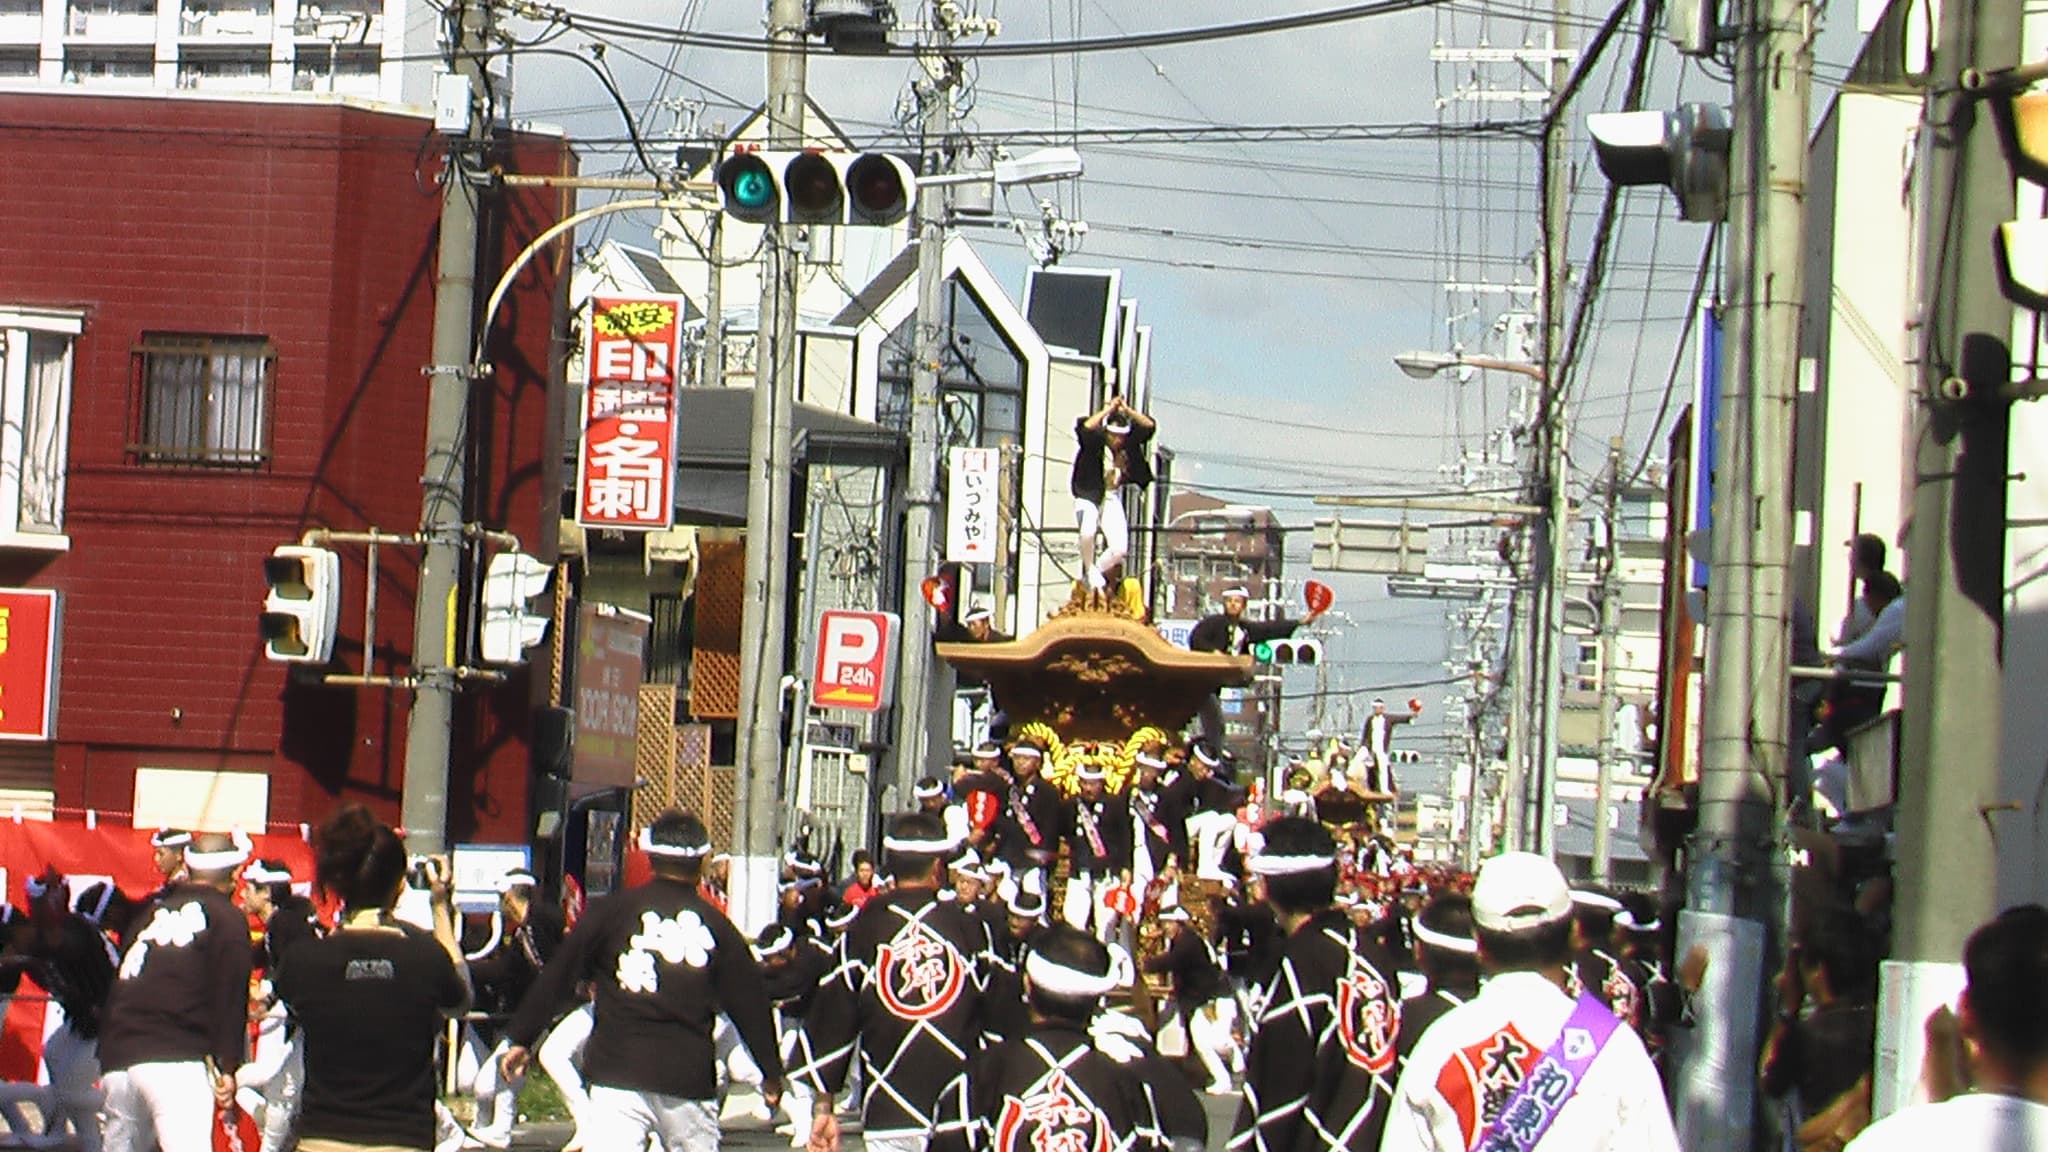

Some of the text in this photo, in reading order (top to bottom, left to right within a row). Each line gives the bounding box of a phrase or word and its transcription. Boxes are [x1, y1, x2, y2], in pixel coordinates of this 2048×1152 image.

[604, 308, 664, 331] 激安
[962, 474, 983, 541] いつみや
[822, 615, 880, 684] P
[839, 665, 876, 687] 24h
